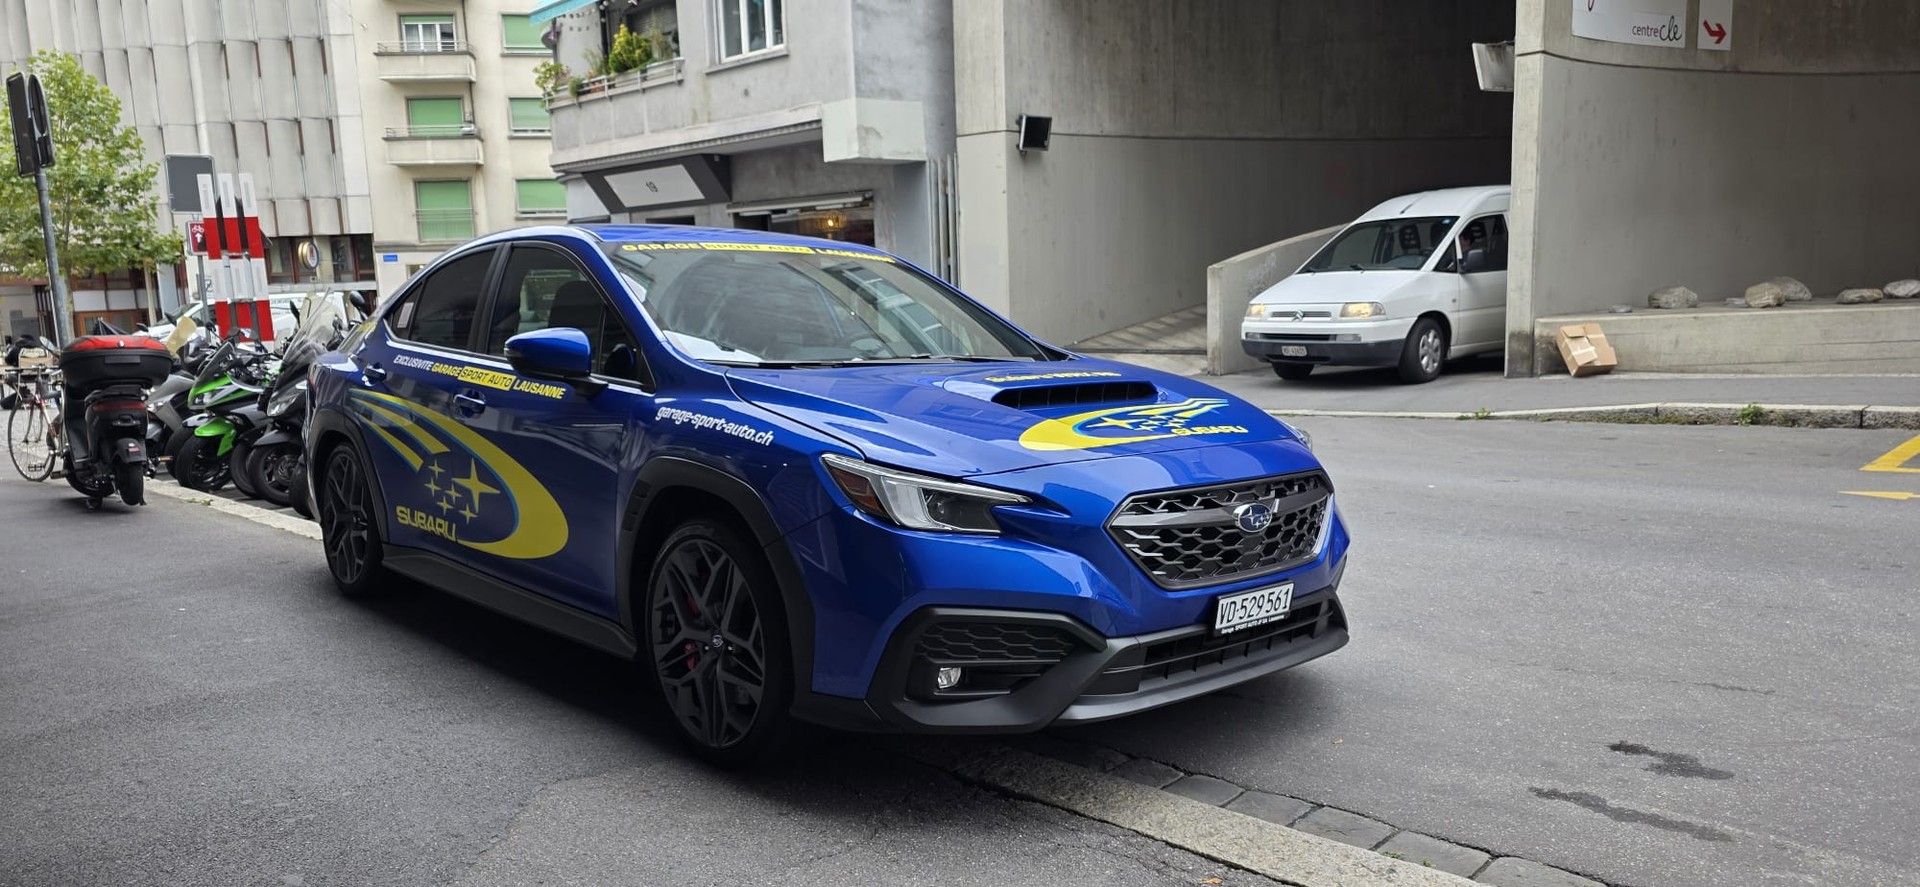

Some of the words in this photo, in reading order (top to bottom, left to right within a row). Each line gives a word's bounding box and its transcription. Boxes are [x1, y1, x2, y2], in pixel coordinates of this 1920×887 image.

[1631, 23, 1659, 38] centre
[645, 181, 658, 193] 19
[621, 242, 702, 251] GARAGE
[703, 243, 761, 251] SPORT
[769, 245, 811, 253] AUTO
[815, 248, 896, 263] LAUSANNE
[393, 354, 433, 370] EXCLUSIVITE
[431, 362, 463, 377] GARAGE
[461, 368, 490, 384] SPORT
[488, 373, 513, 389] AUTO
[513, 379, 567, 399] LAUSANNE
[655, 406, 774, 446] garage-sport-auto.ch
[1170, 425, 1249, 436] SUBARU
[395, 505, 456, 542] SUBARU
